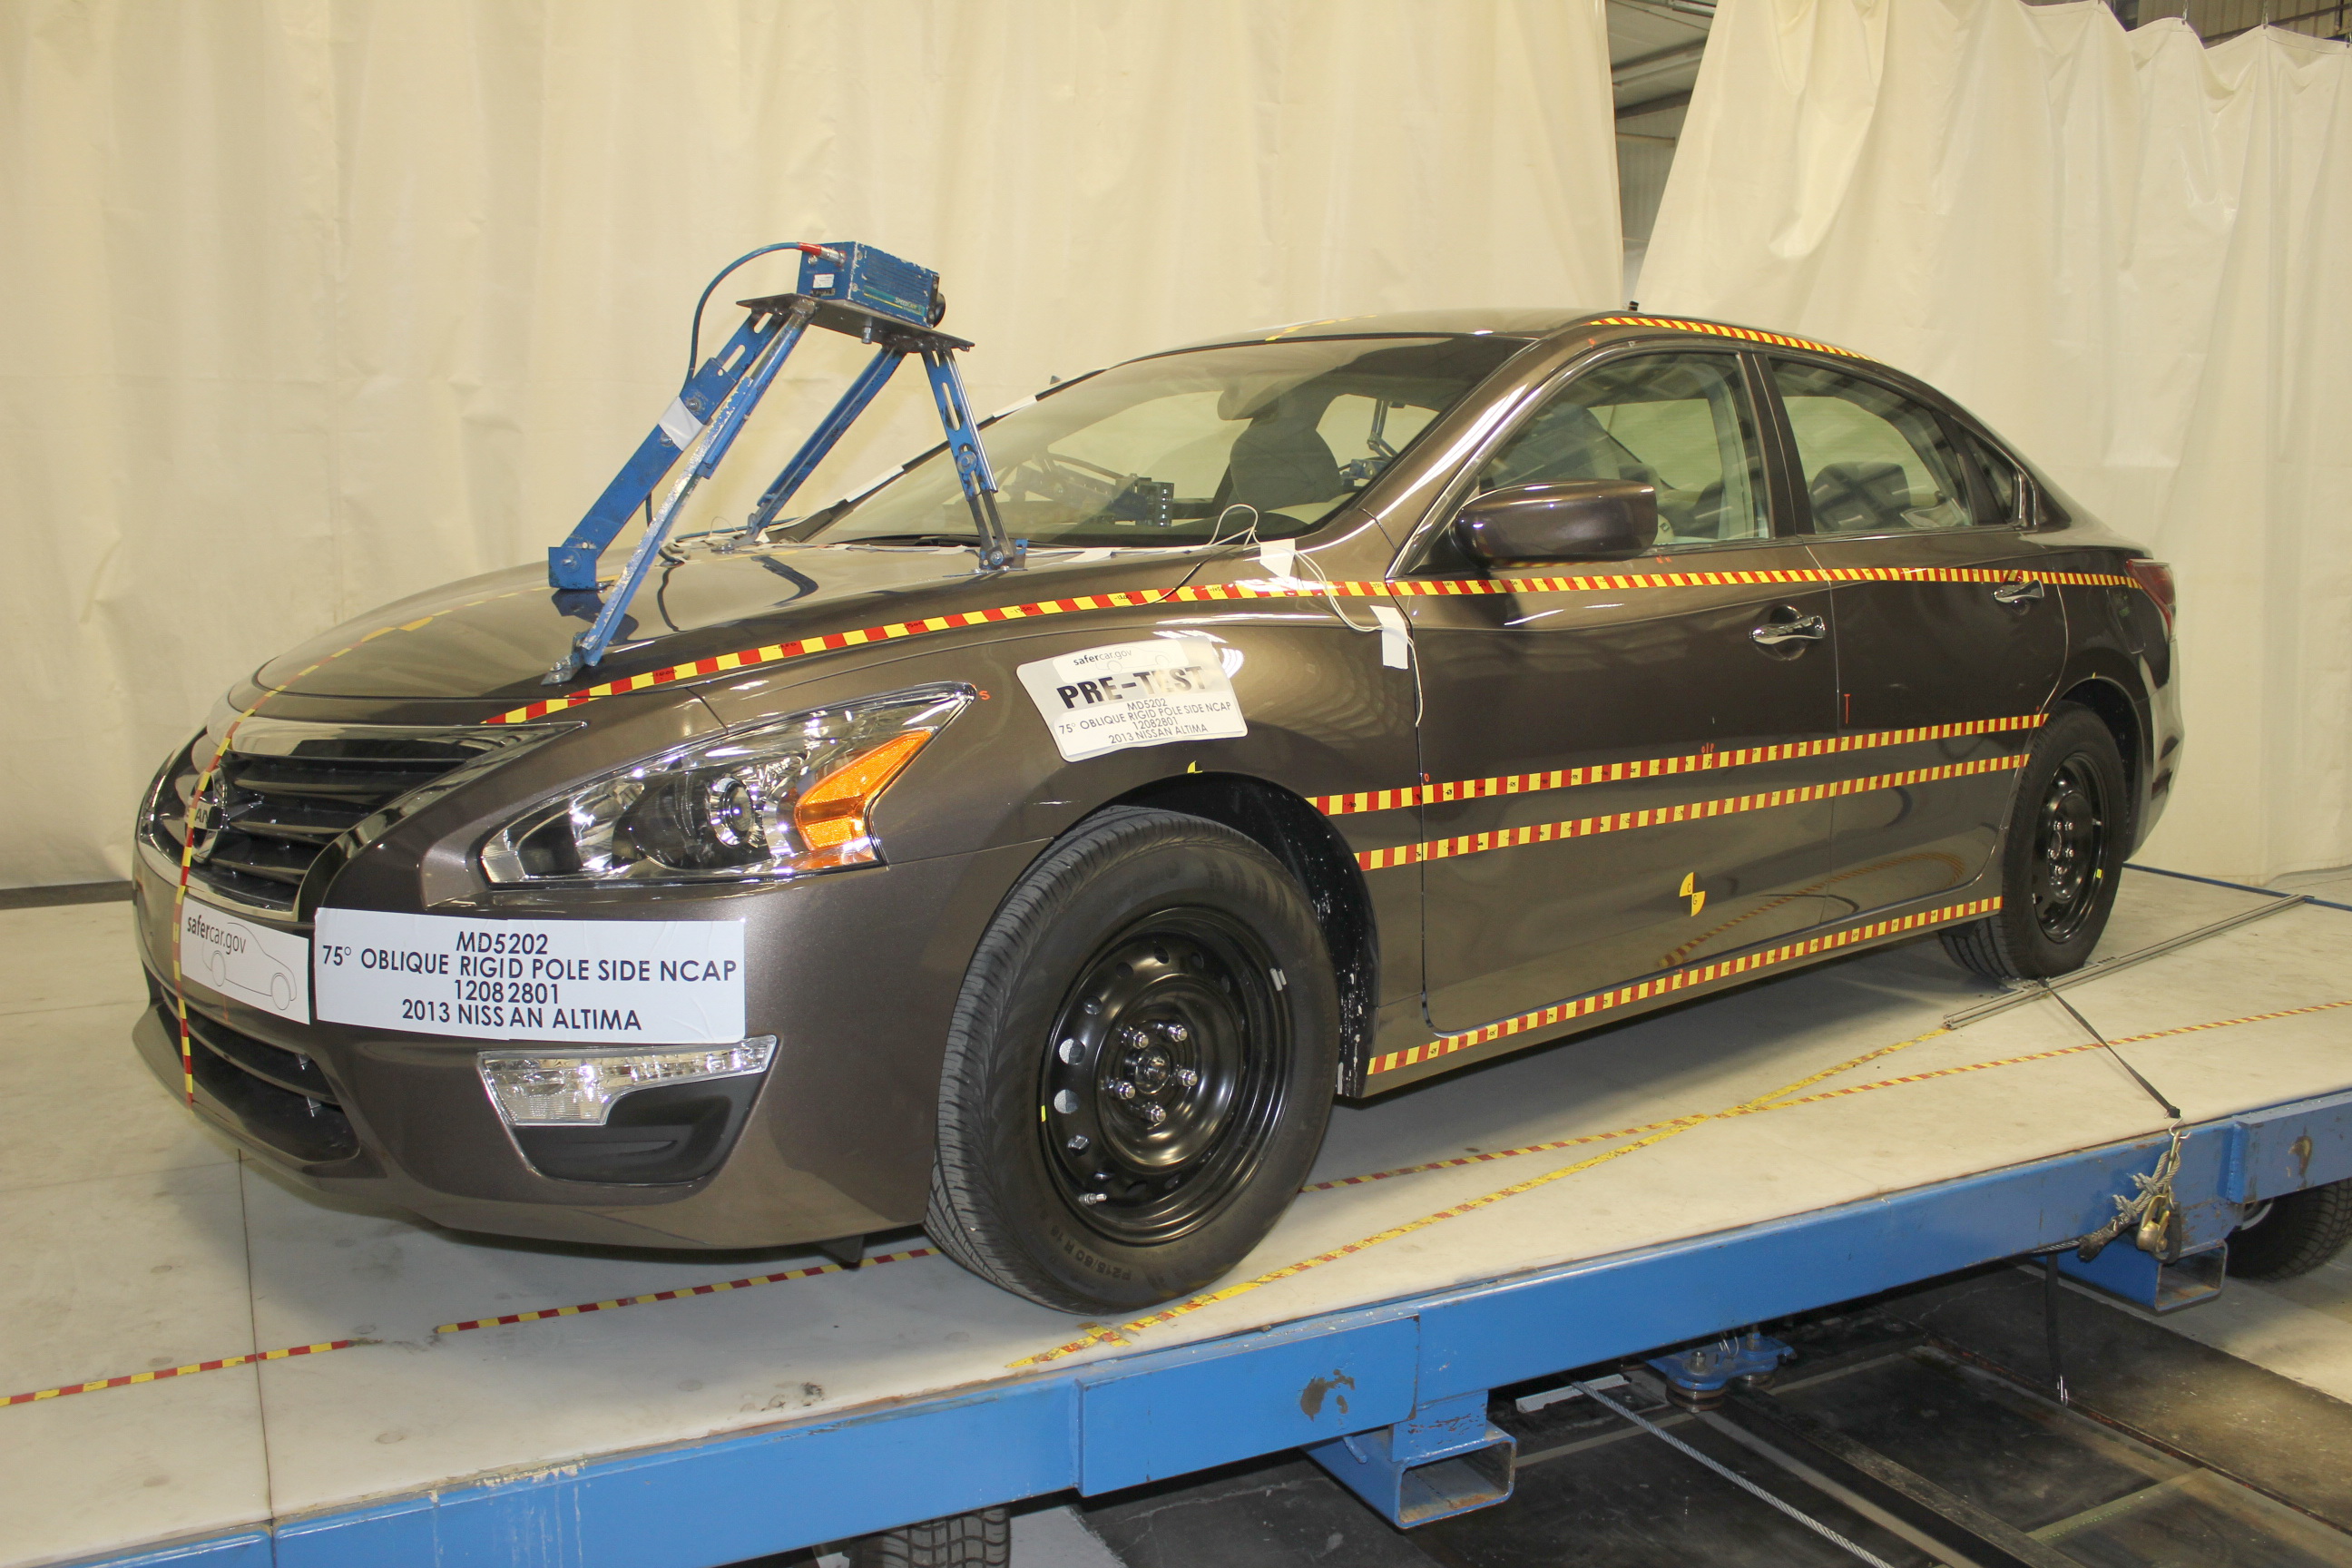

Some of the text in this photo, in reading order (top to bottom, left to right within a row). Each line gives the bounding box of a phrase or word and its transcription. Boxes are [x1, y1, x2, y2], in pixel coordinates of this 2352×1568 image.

[1073, 649, 1132, 666] safercar.gov
[1080, 713, 1126, 730] OBLIQUE
[1127, 709, 1157, 721] RIGID
[1159, 706, 1183, 717] POLE
[1183, 703, 1205, 714] SIDE
[1205, 701, 1231, 712] NCAP
[1127, 698, 1168, 711] MD5202
[1108, 723, 1209, 744] 2013 NISSAN ALTIMA
[1132, 716, 1179, 730] 12082801
[187, 915, 247, 955] safercar.gov
[456, 931, 548, 955] MD5202
[322, 945, 737, 982] 75° OBLIQUE RIGID POLE SIDE NCAP
[454, 979, 558, 1004] 12082801
[402, 998, 642, 1031] 2013 NISSAN ALTIMA
